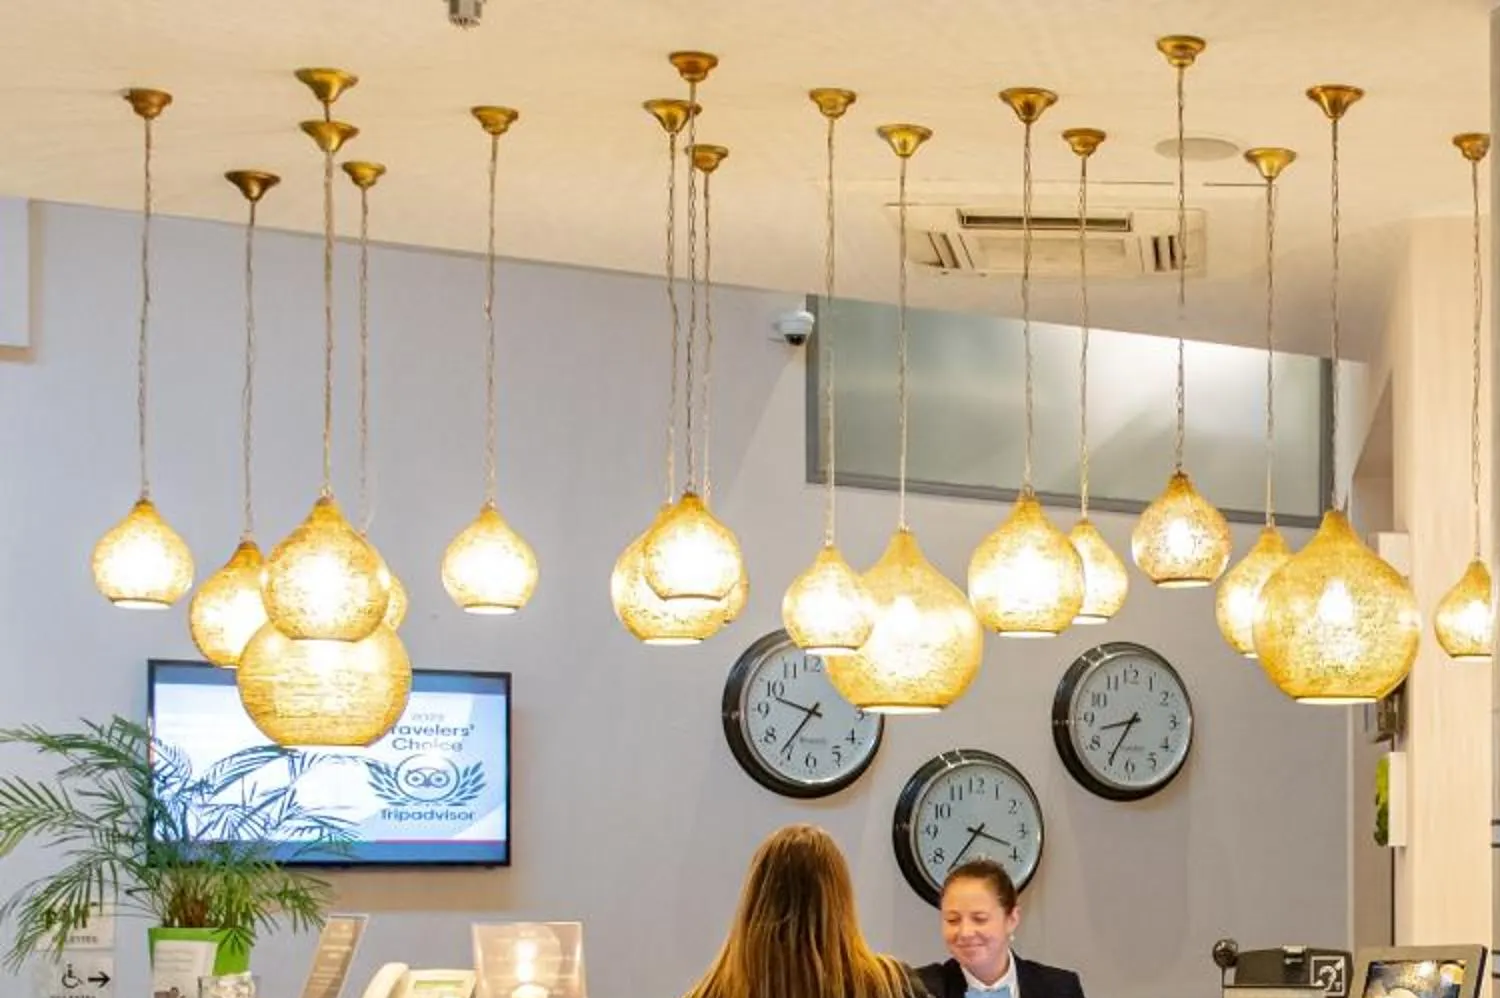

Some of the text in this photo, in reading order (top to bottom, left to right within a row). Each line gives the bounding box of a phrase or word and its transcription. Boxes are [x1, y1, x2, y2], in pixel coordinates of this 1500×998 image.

[784, 662, 797, 679] 11
[803, 655, 822, 672] 12
[1106, 675, 1119, 691] 11
[1123, 669, 1139, 685] 12
[767, 680, 785, 697] 10
[1091, 691, 1107, 708] 10
[1160, 691, 1169, 706] 2
[757, 702, 769, 719] 9
[1083, 711, 1095, 727] 9
[1169, 714, 1177, 730] 3
[391, 723, 476, 737] ravelers'
[764, 726, 777, 744] 8
[845, 728, 855, 744] 4
[392, 737, 463, 752] Choice
[1089, 734, 1101, 751] 8
[1159, 736, 1169, 752] 4
[805, 752, 817, 768] 6
[832, 745, 842, 767] 5
[1147, 751, 1157, 771] 5
[1124, 759, 1135, 775] 6
[950, 784, 963, 800] 11
[969, 776, 985, 794] 12
[382, 808, 475, 821] Tripadvisor
[935, 803, 951, 820] 10
[1008, 799, 1017, 815] 2
[925, 823, 938, 840] 9
[1018, 822, 1026, 839] 3
[933, 847, 945, 864] 8
[1008, 846, 1017, 862] 4
